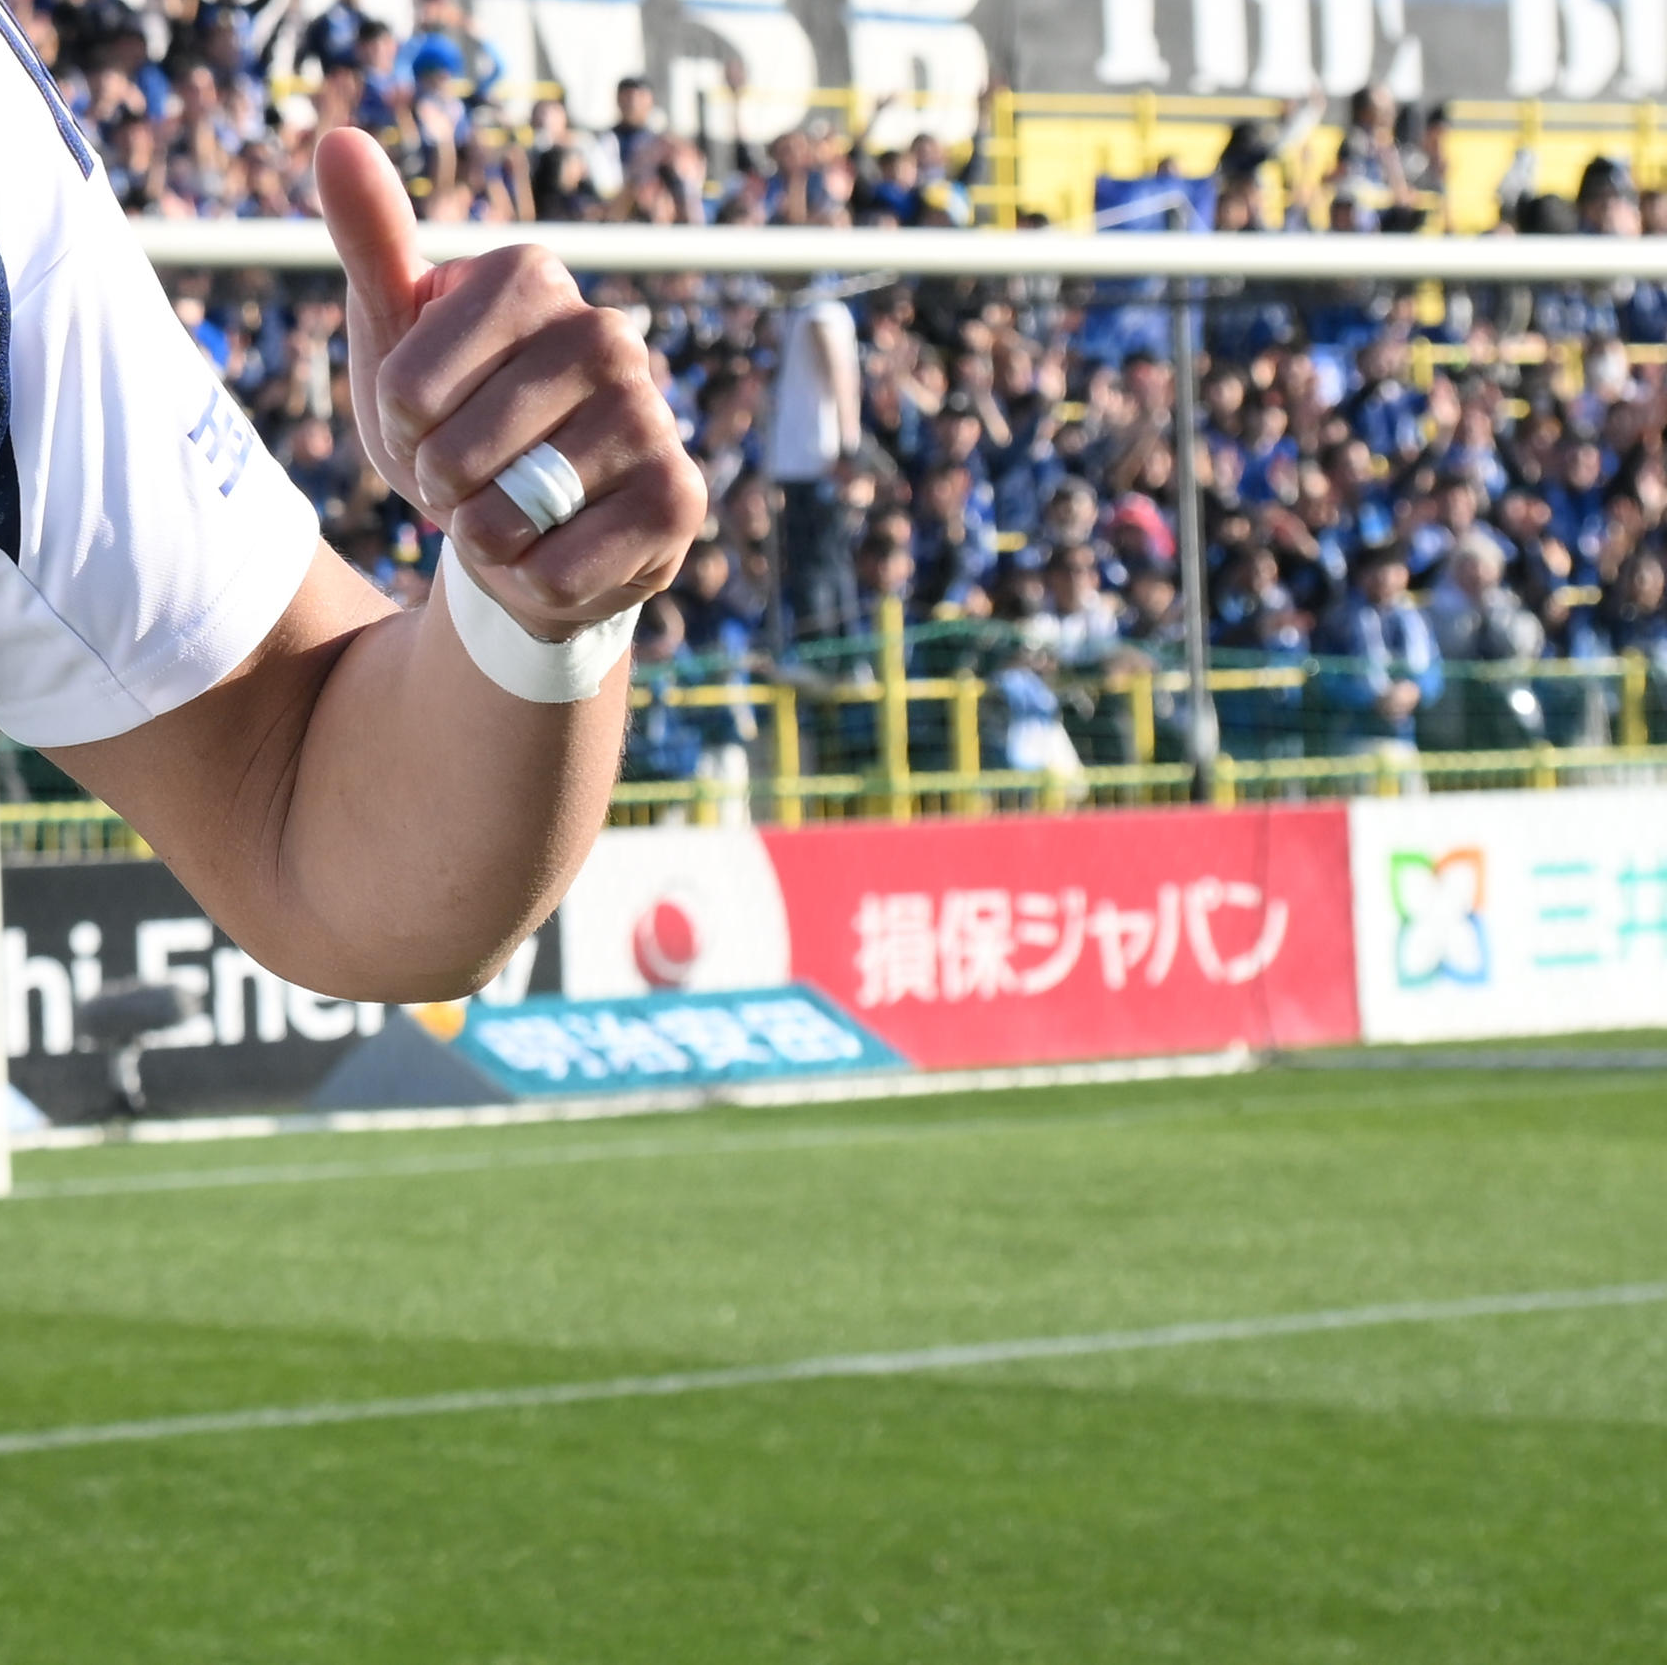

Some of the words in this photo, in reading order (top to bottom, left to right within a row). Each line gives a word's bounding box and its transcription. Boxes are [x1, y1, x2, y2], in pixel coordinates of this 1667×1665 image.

[853, 878, 1289, 1005] 損保ジャパン
